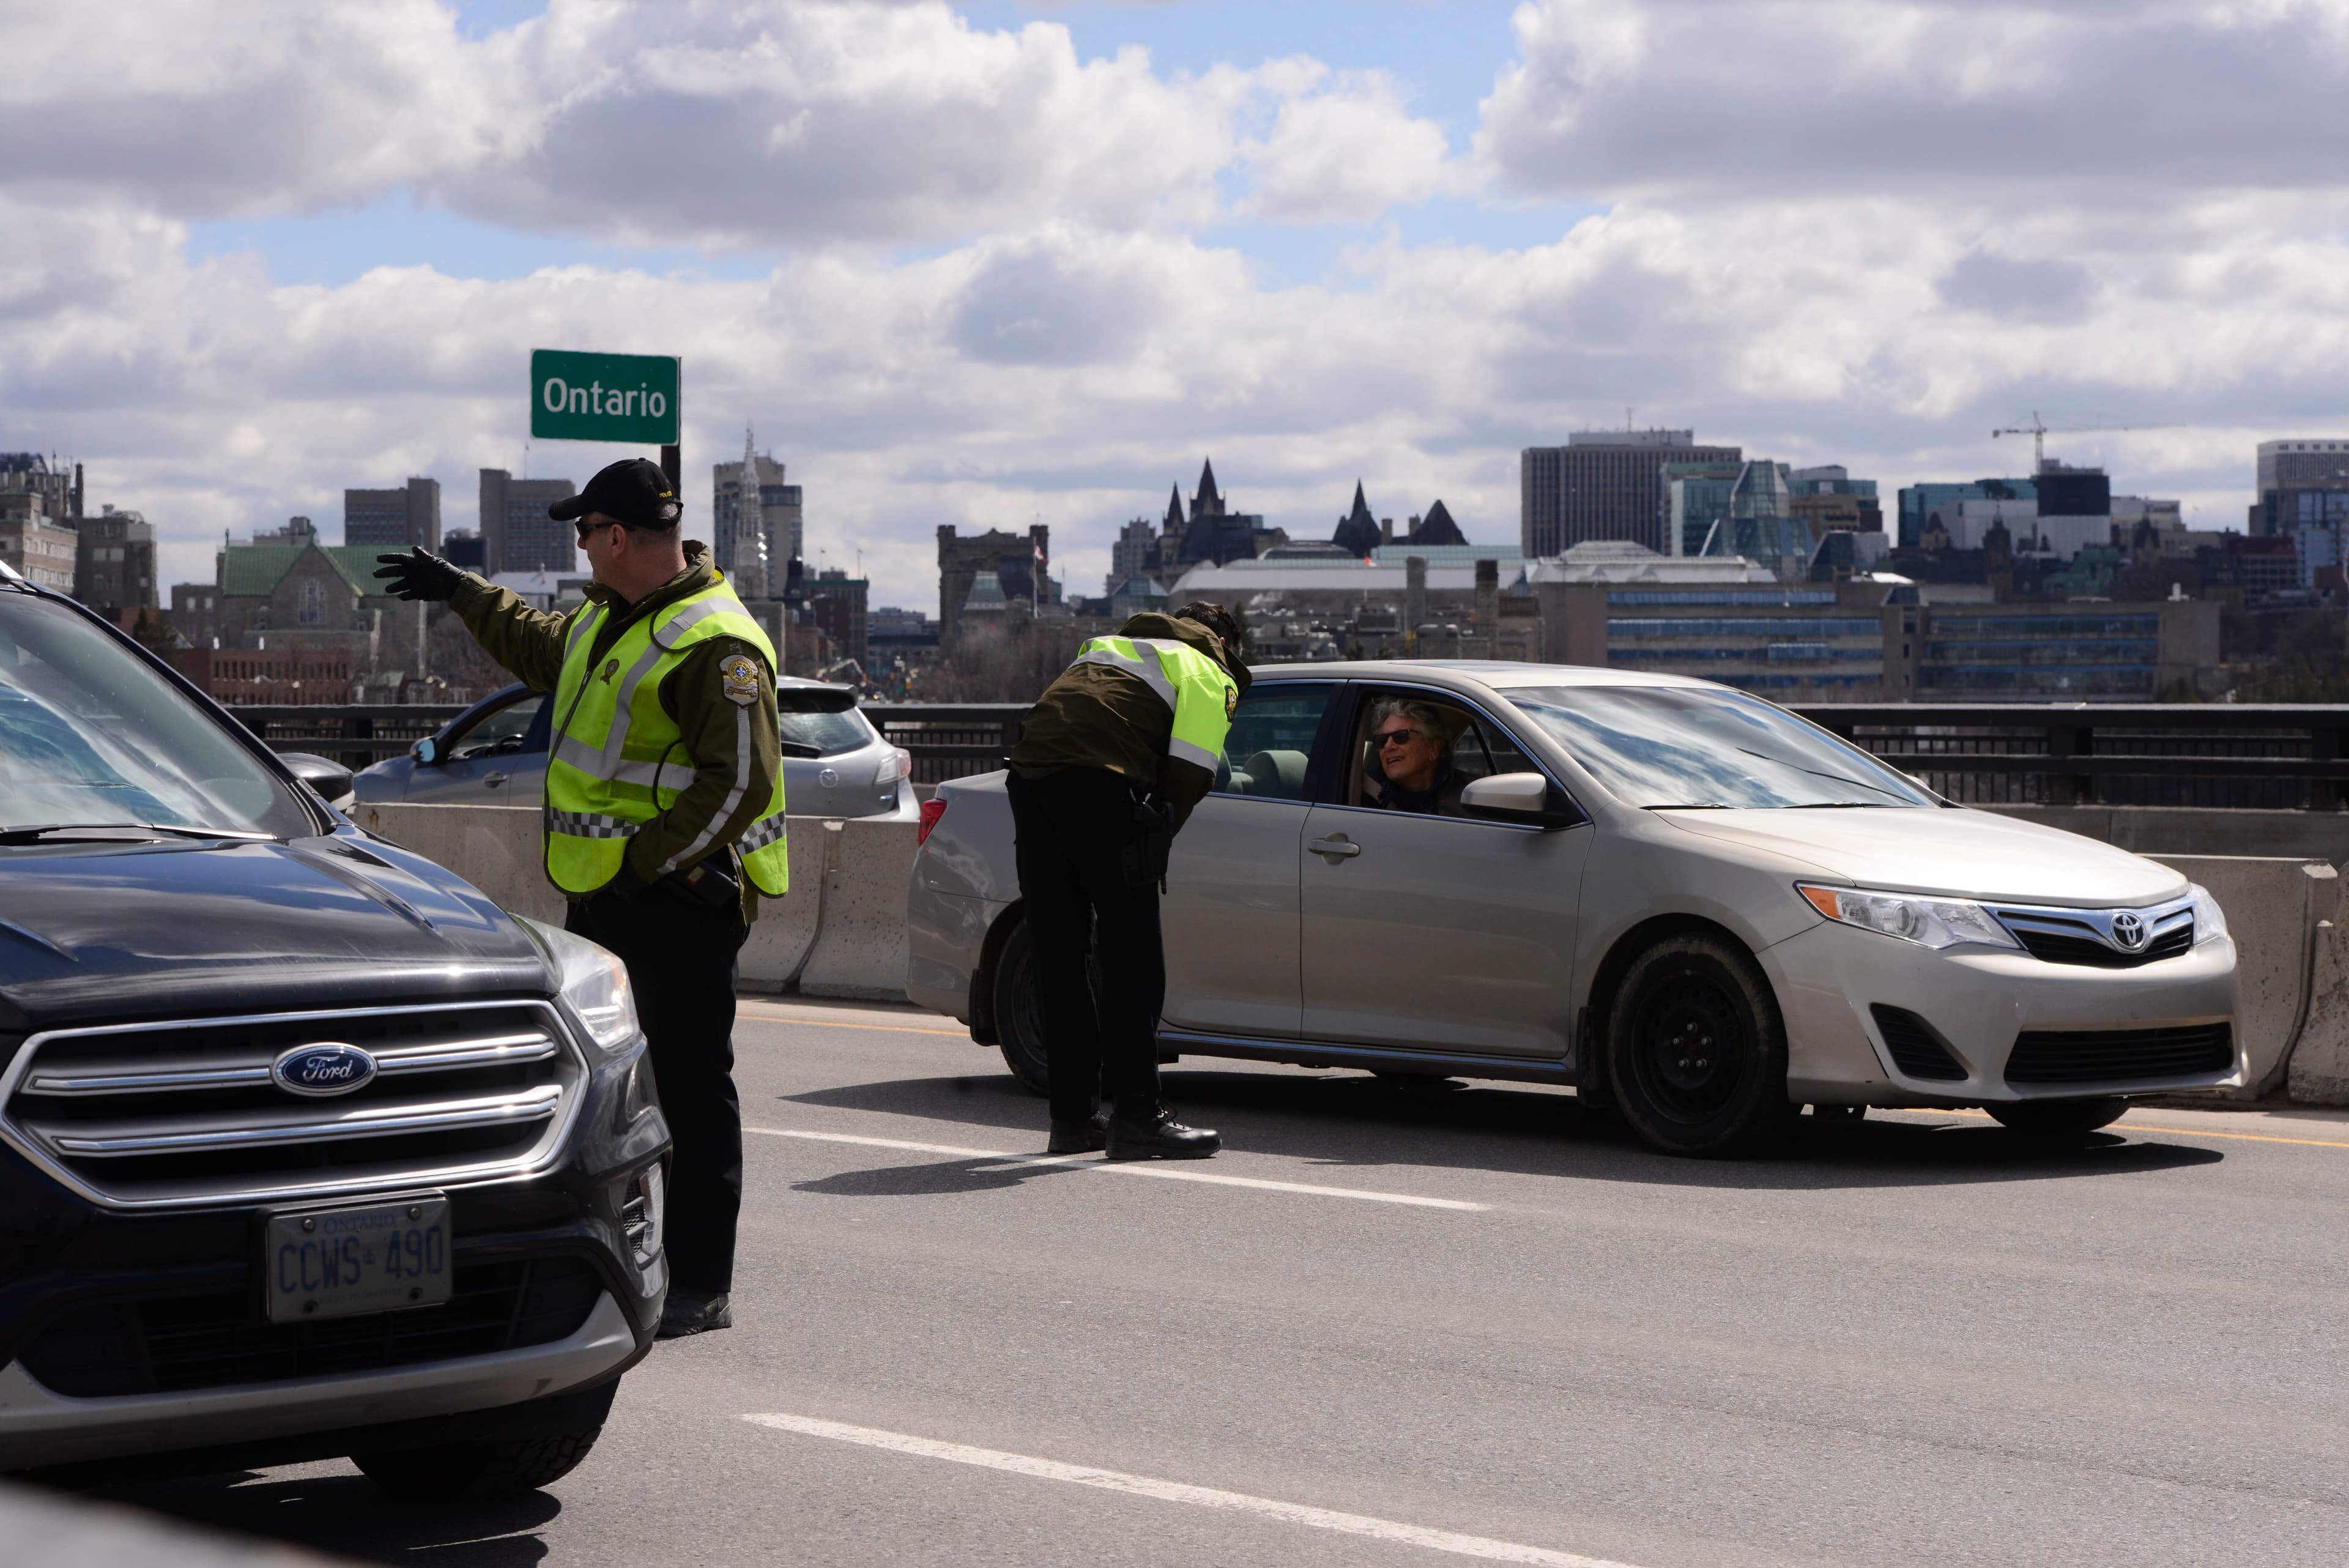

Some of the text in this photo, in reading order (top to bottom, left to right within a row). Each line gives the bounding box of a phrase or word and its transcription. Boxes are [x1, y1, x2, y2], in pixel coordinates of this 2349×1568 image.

[544, 377, 666, 417] Ontario
[302, 1055, 353, 1082] Ford
[324, 1213, 396, 1235] ONTARIO
[279, 1225, 443, 1294] CCWS 490
